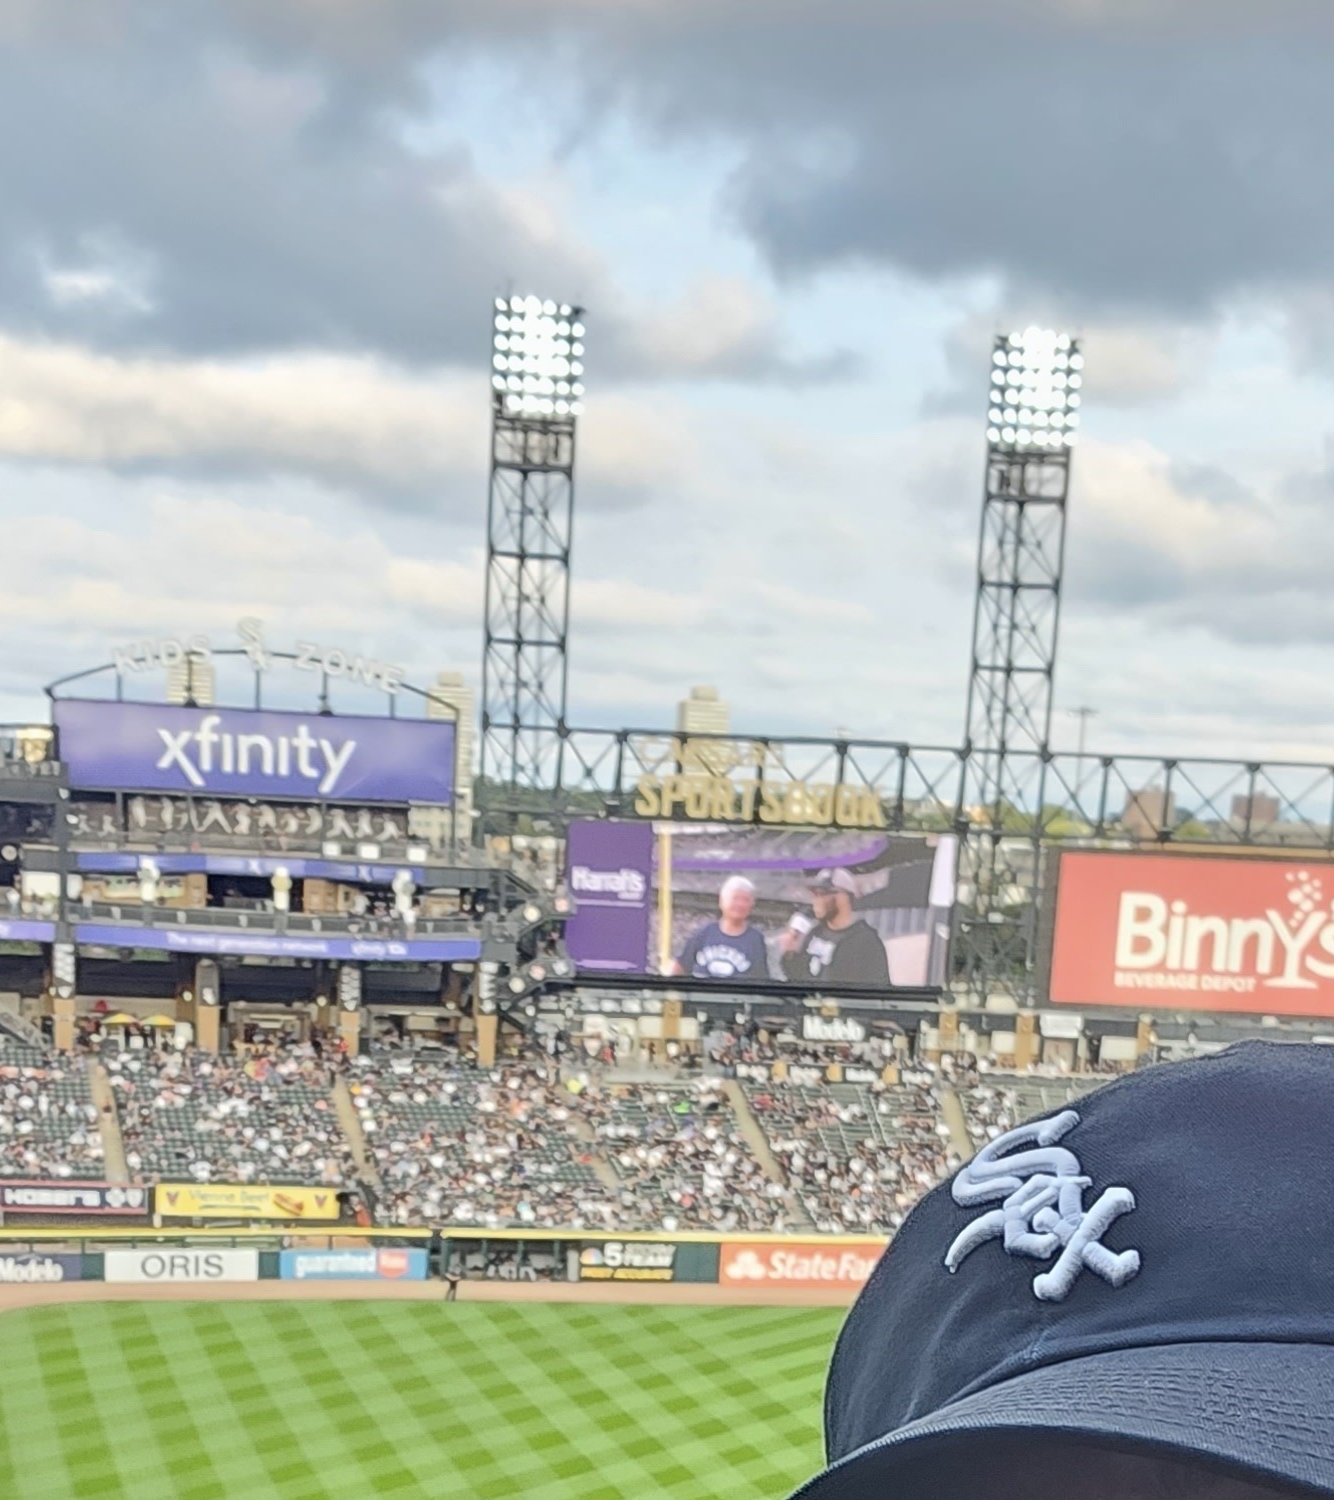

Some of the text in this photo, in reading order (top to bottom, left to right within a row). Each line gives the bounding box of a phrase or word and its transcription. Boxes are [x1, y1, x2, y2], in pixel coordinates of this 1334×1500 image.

[113, 635, 213, 676] KIDS
[294, 641, 405, 695] ZONE
[156, 715, 357, 794] xfinity
[635, 773, 887, 828] SPORTSBOOK
[1114, 969, 1257, 992] BEVERAGE DEPOT
[141, 1254, 225, 1279] ORIS
